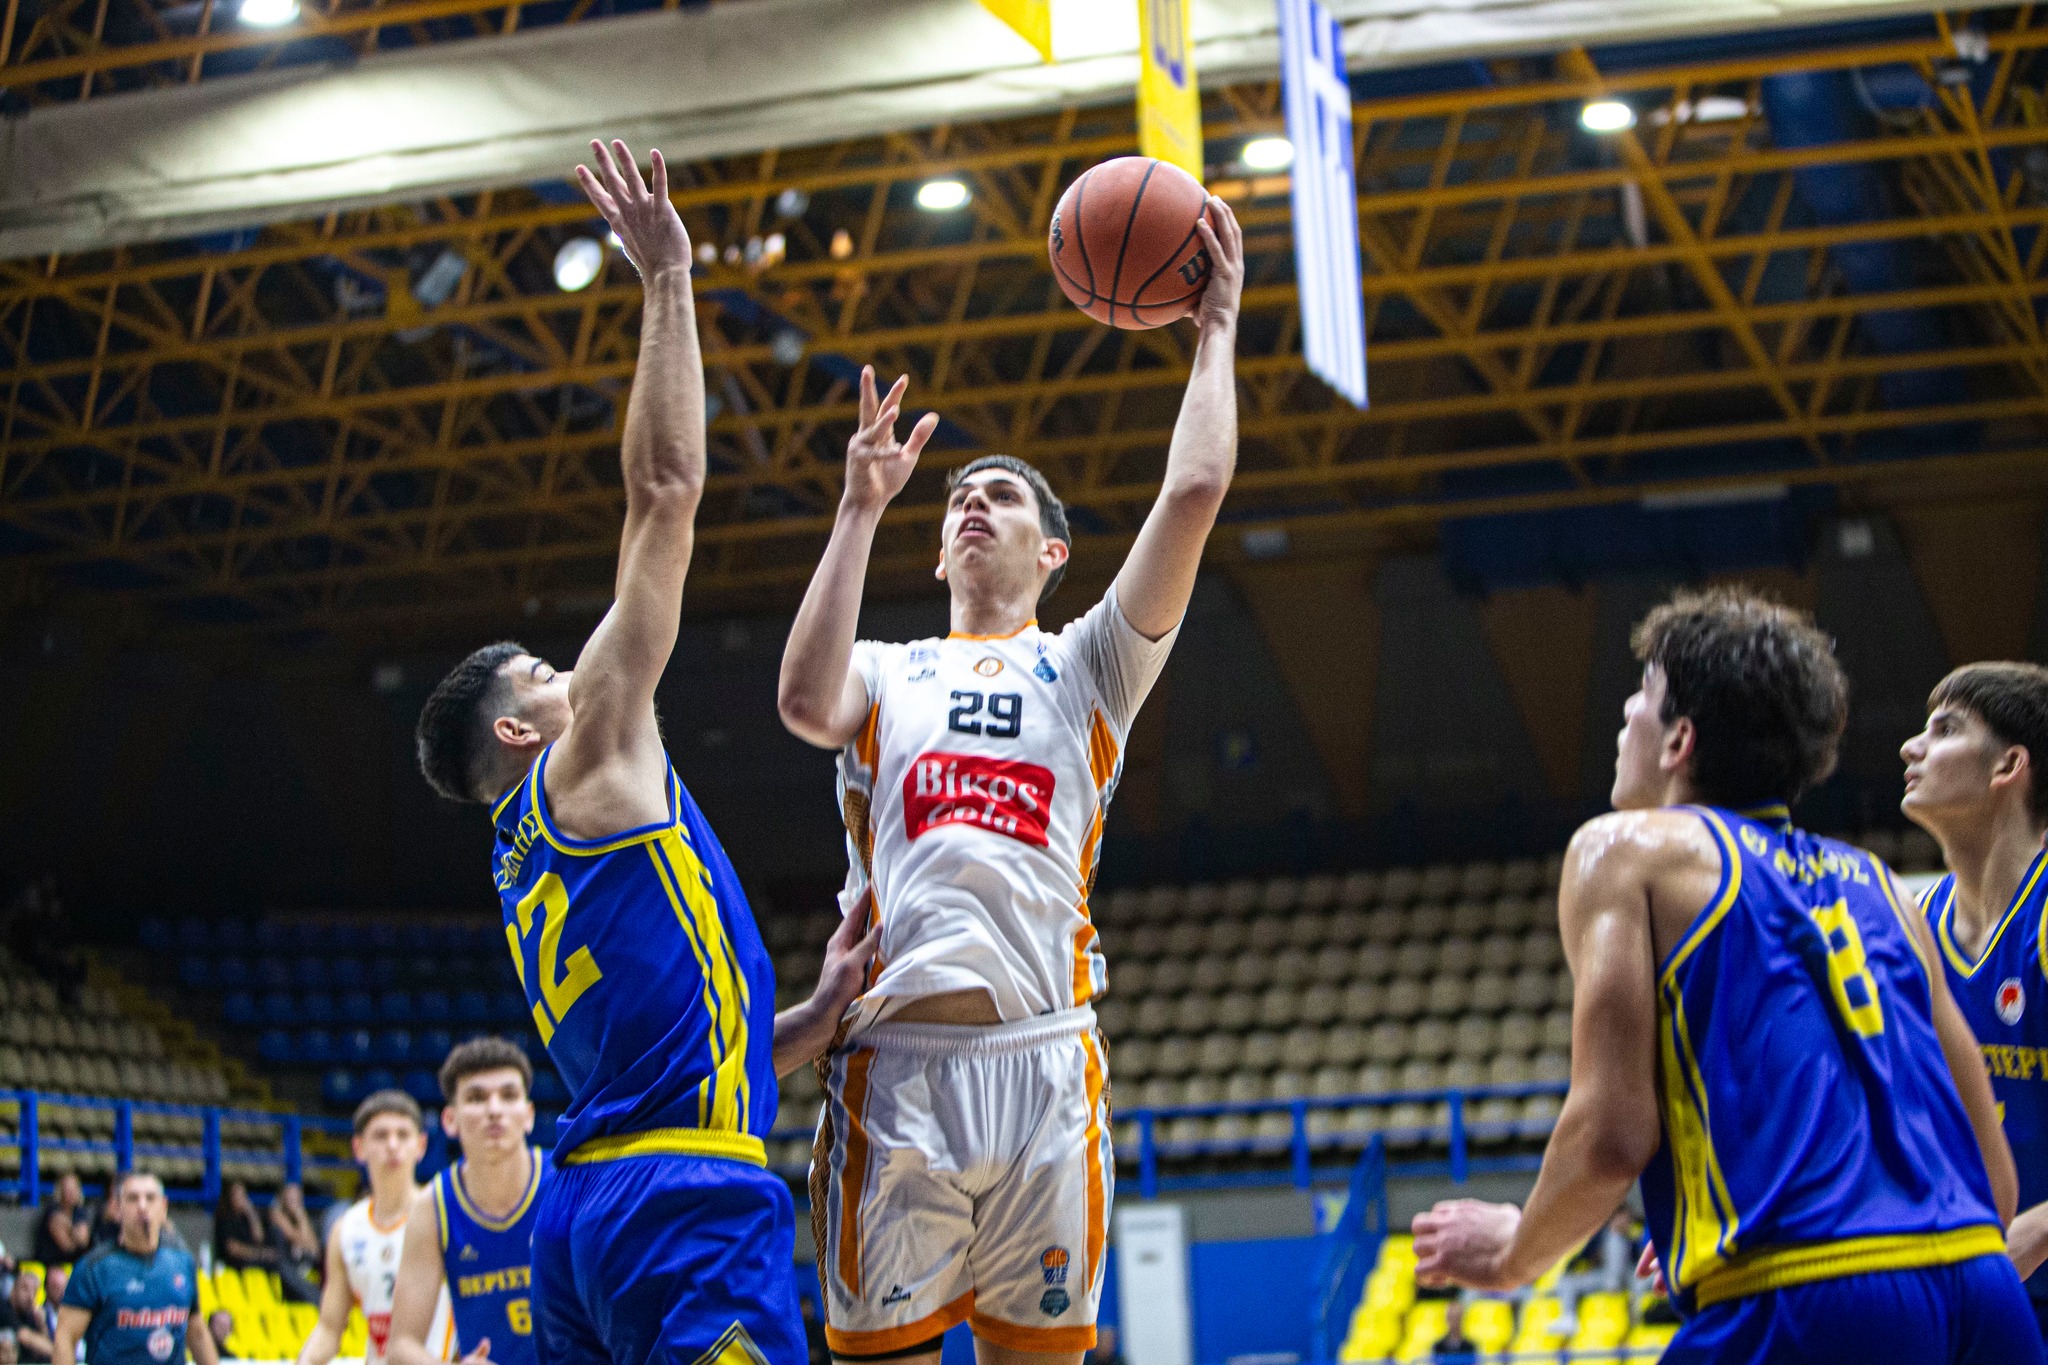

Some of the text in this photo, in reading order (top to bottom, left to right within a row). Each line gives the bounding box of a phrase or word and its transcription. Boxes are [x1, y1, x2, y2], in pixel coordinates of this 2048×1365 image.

[948, 690, 1022, 738] 29
[1811, 897, 1885, 1038] 8
[506, 1297, 532, 1336] 6
